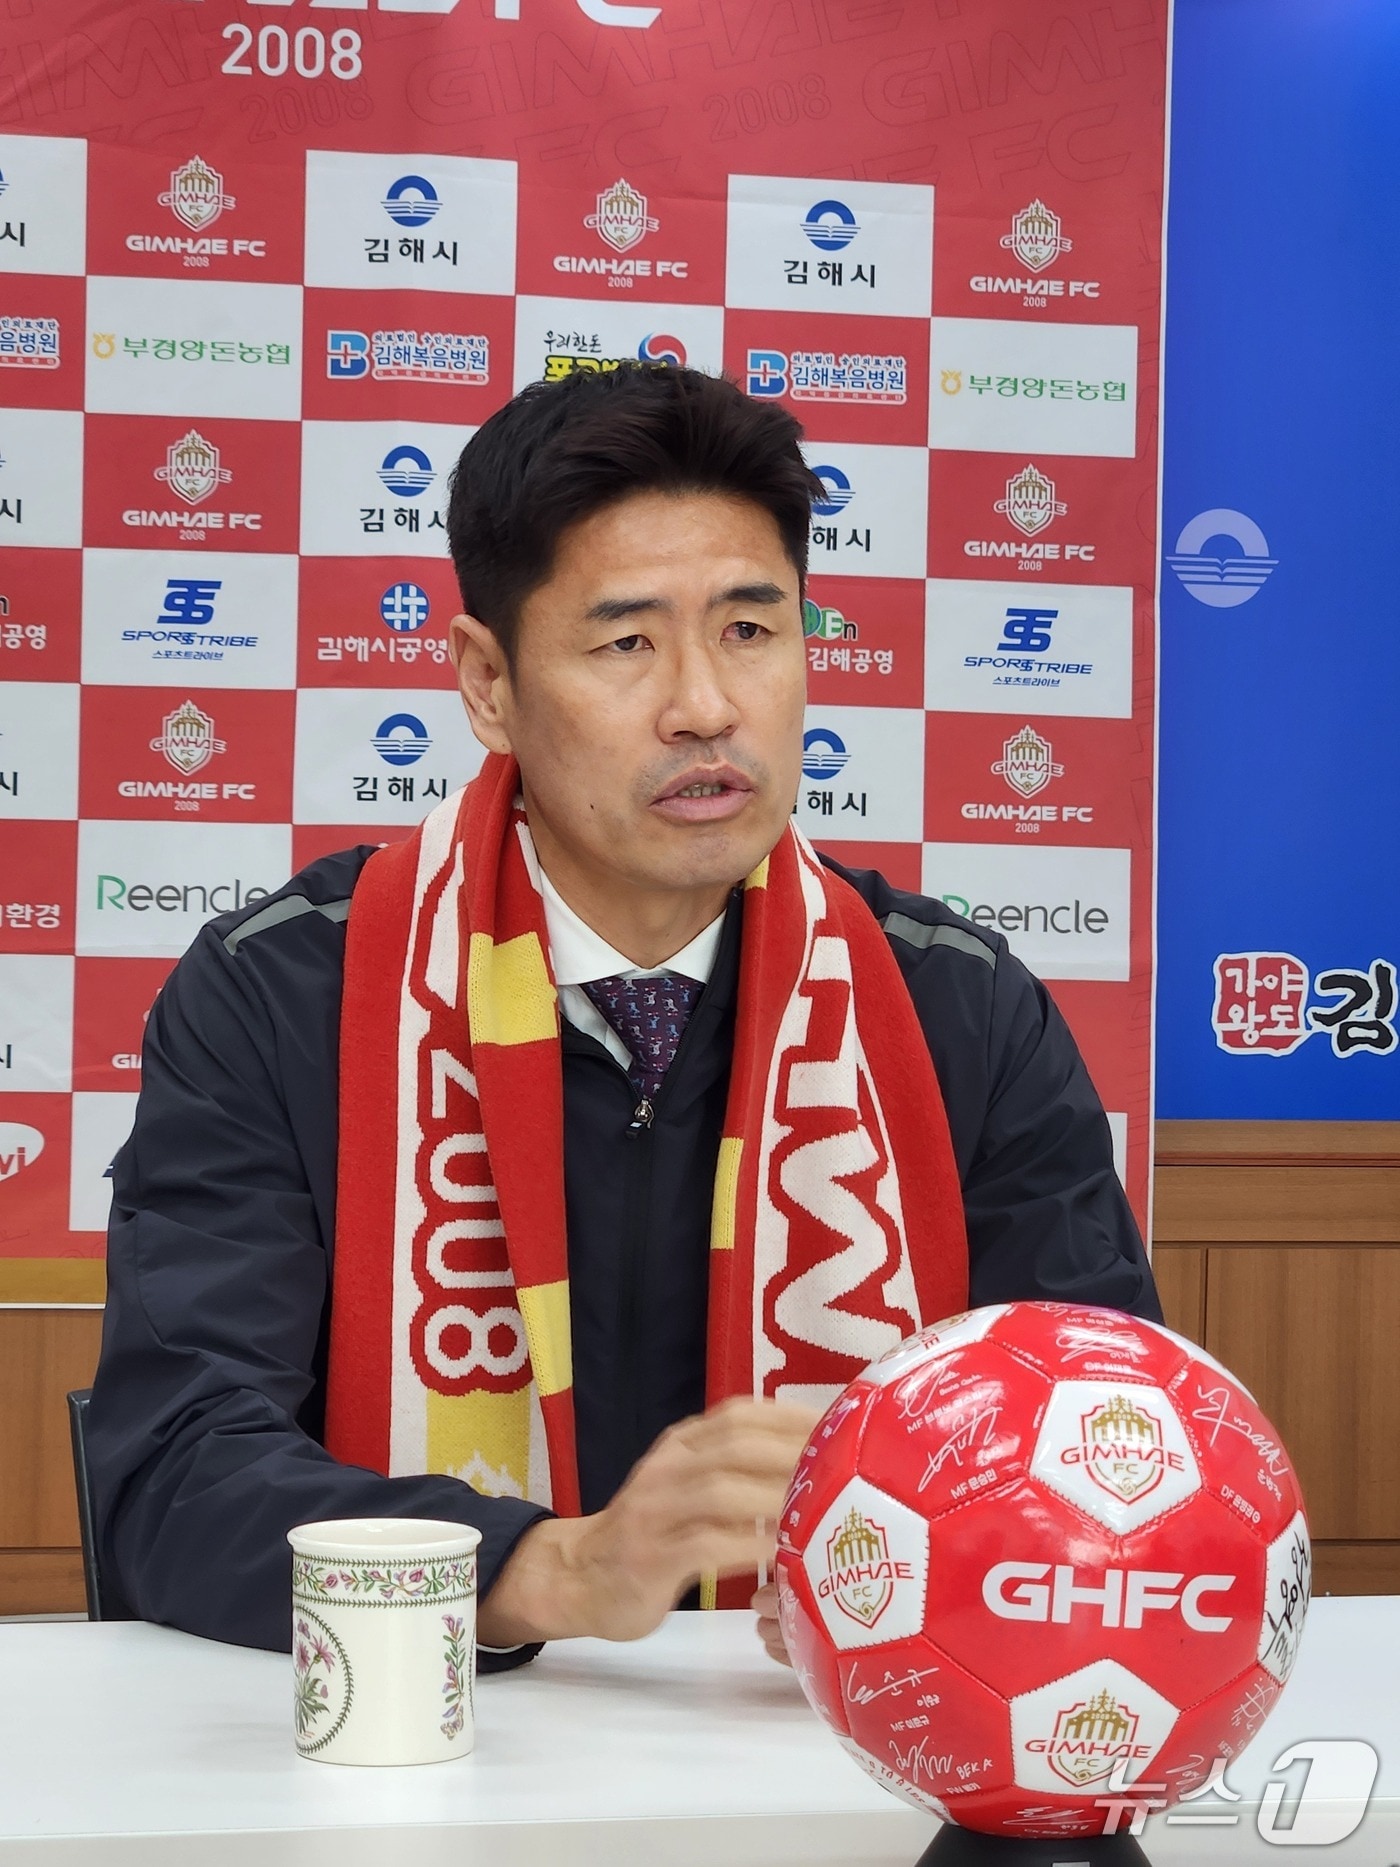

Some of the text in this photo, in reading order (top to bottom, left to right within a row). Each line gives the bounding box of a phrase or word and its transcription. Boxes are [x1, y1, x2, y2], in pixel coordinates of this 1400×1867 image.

[221, 23, 362, 80] 2008
[160, 193, 235, 209] GIMHAE
[586, 215, 659, 231] GIMHAE
[126, 235, 266, 257] GIMHAE FC
[364, 238, 458, 266] 김해시
[1002, 235, 1072, 251] GIMHAE
[183, 256, 210, 267] 2008
[553, 256, 688, 278] GIMHAE FC
[608, 276, 633, 288] 2008
[784, 260, 876, 288] 김해시
[970, 276, 1100, 298] GIMHAE FC
[1023, 296, 1047, 308] 2008
[123, 337, 291, 365] 부경양돈농협
[544, 330, 602, 353] 우리한돈
[374, 345, 486, 371] 김해복음병원
[793, 366, 904, 390] 김해복음병원
[969, 375, 1126, 402] 부경양돈농협
[157, 467, 232, 483] GIMHAE
[995, 500, 1067, 515] GIMHAE
[122, 510, 262, 530] GIMHAE FC
[179, 530, 206, 541] 2008
[964, 541, 1095, 561] GIMHAE FC
[1018, 560, 1042, 571] 2008
[1, 624, 46, 650] 공영
[152, 650, 224, 661] 스포츠트라이브
[808, 647, 893, 674] 김해공영
[992, 676, 1060, 687] 스포츠트라이브
[152, 737, 227, 753] GIMHAE
[993, 761, 1064, 777] GIMHAE
[118, 781, 256, 800] GIMHAE FC
[352, 777, 447, 801] 김해시
[174, 800, 200, 811] 2008
[961, 803, 1093, 822] GIMHAE FC
[1015, 823, 1039, 833] 2008
[1, 902, 61, 928] 환경
[1312, 963, 1394, 1052] 김
[907, 1418, 924, 1434] MF
[1060, 1443, 1185, 1472] GIMHAE
[1113, 1463, 1139, 1474] FC
[951, 1485, 969, 1499] MF
[1220, 1485, 1235, 1499] DF
[818, 1562, 915, 1598] GIMHAE
[852, 1585, 872, 1600] FC
[981, 1561, 1236, 1633] GHFC
[890, 1721, 905, 1732] MF
[1025, 1739, 1152, 1759] GIMHAE
[1074, 1758, 1100, 1767] FC
